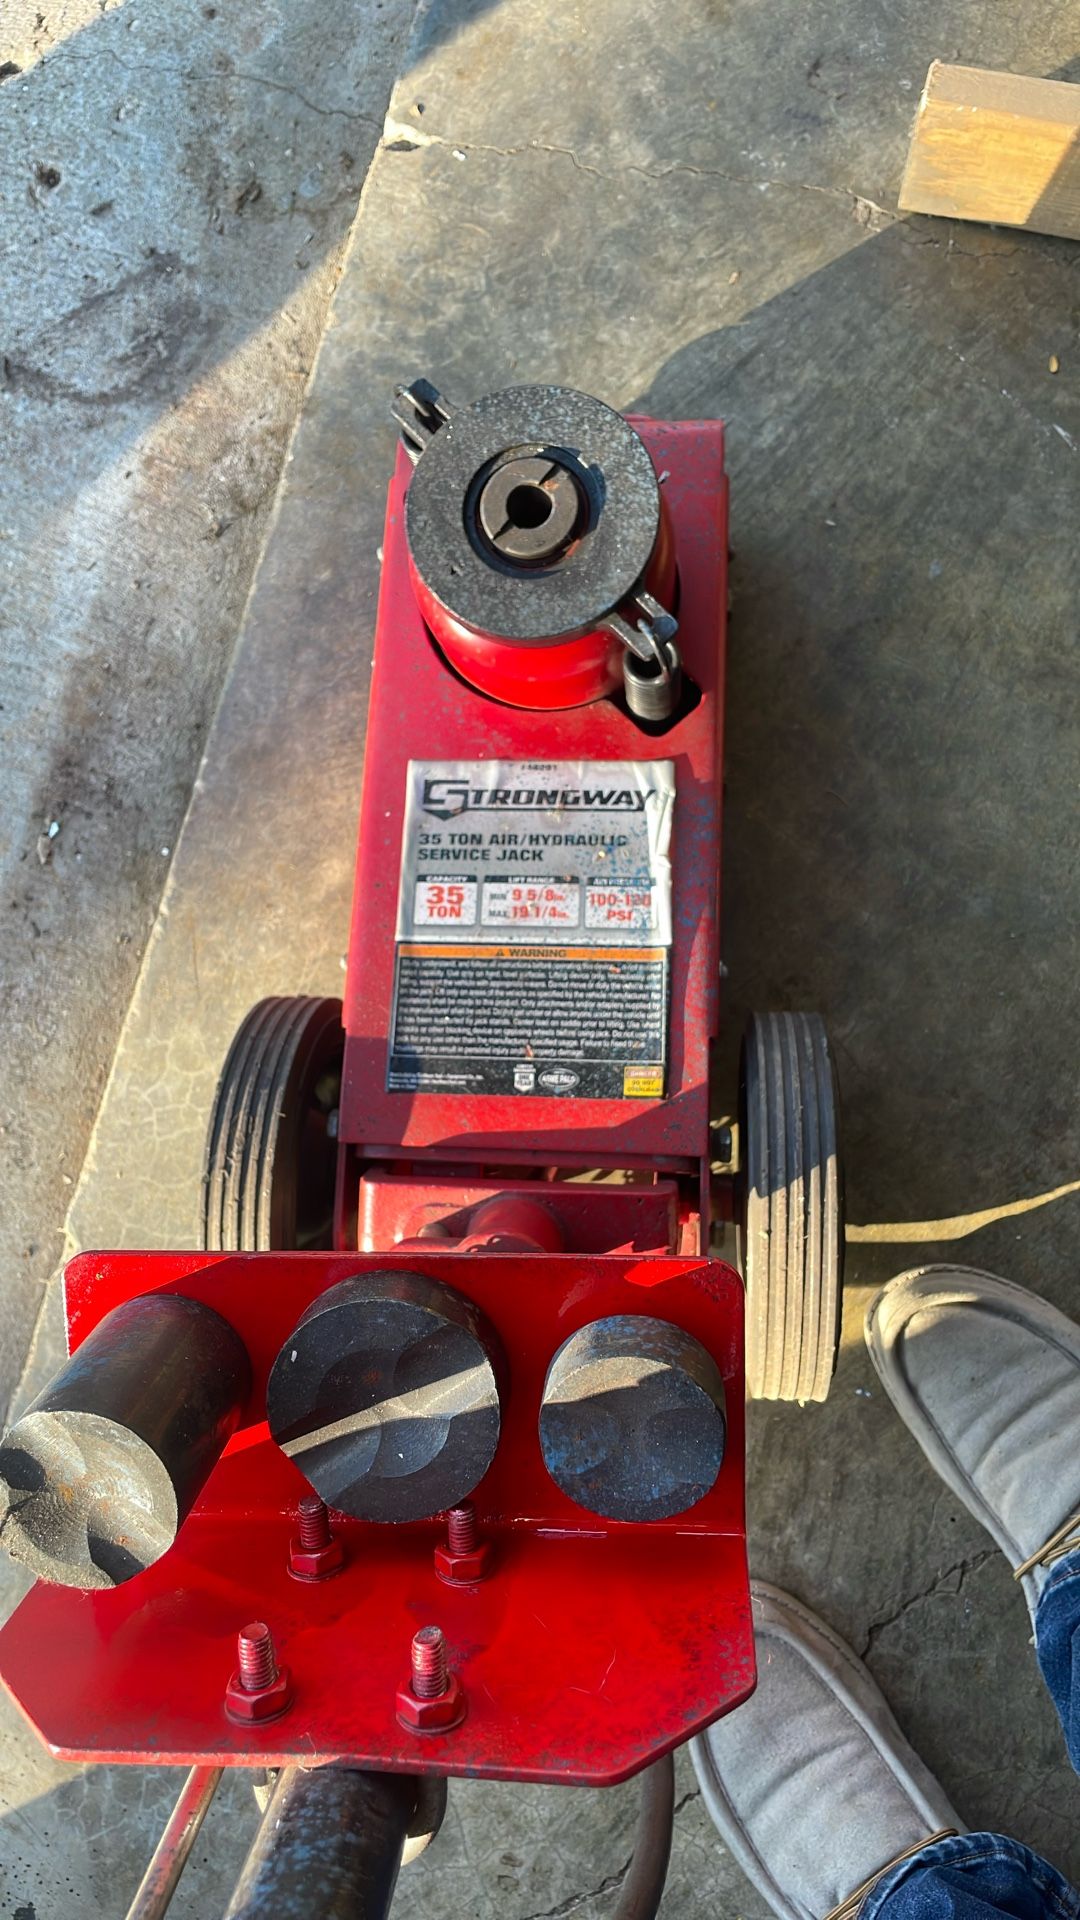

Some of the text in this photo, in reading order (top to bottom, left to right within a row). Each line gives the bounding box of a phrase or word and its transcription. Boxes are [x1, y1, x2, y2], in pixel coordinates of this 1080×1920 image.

[423, 780, 657, 812] STRONGWAY
[419, 833, 628, 847] 35 TON AIR/HYDRAULIC
[418, 849, 544, 861] SERVICE JACK
[426, 886, 465, 905] 35
[512, 889, 522, 901] 9
[428, 906, 462, 918] TON
[512, 906, 529, 918] 19
[607, 910, 633, 920] PSI
[510, 948, 567, 958] WARNING
